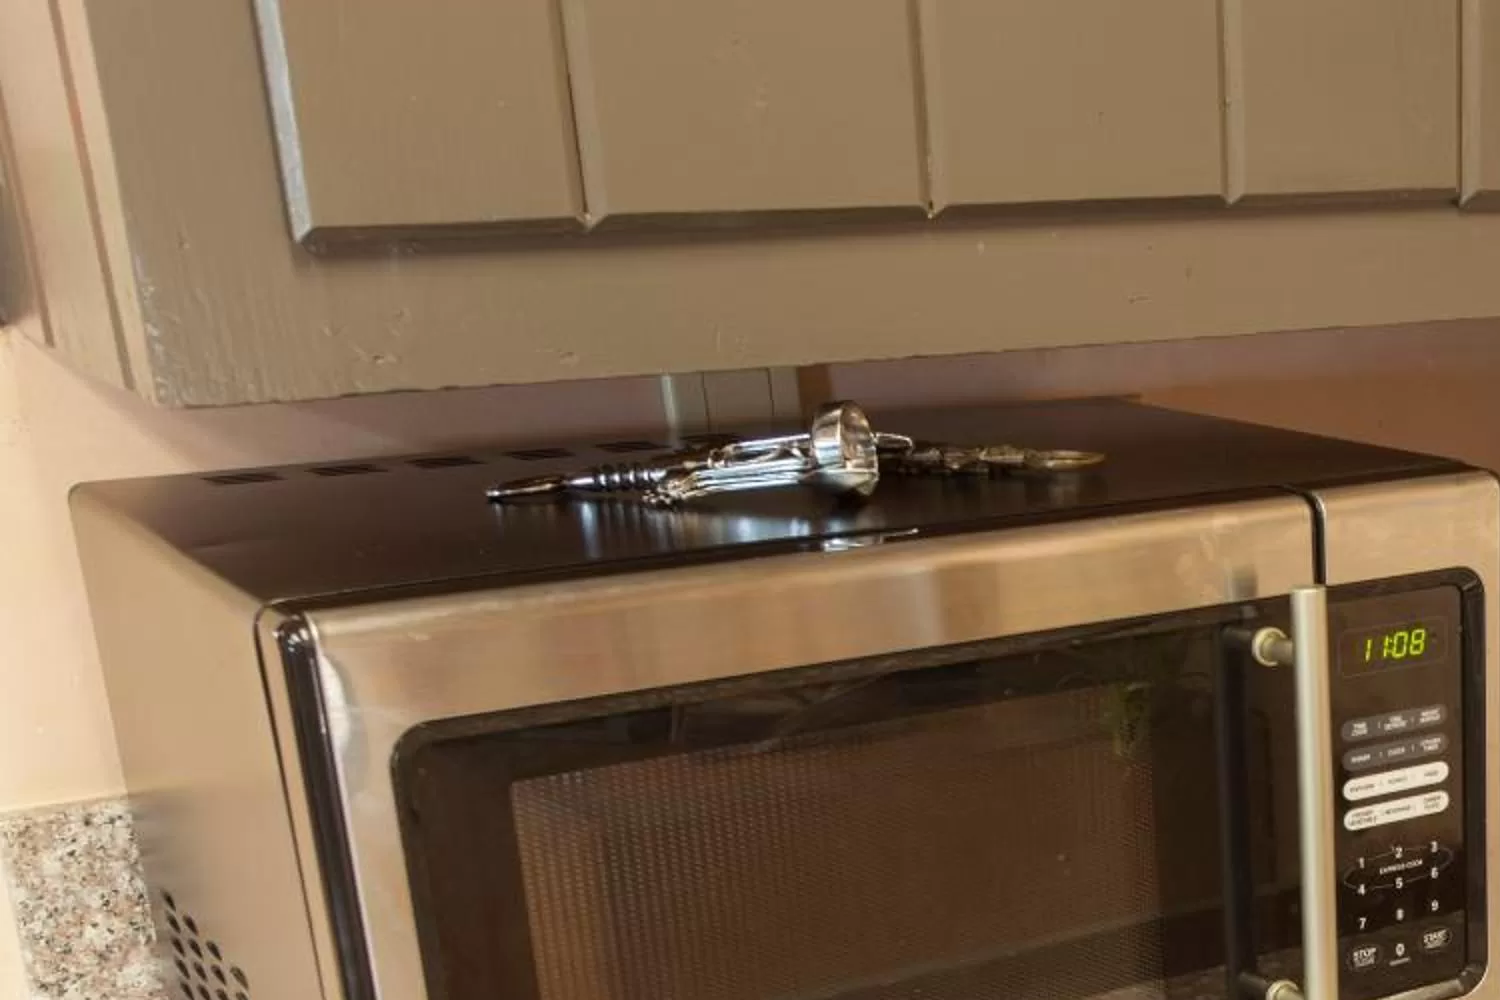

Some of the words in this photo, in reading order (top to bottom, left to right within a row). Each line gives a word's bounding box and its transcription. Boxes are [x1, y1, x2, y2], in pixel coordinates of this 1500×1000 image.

[1364, 627, 1427, 662] 11:08
[1431, 867, 1439, 879] 6
[1357, 883, 1366, 895] 4
[1395, 877, 1404, 889] 5
[1431, 899, 1439, 911] 9
[1359, 917, 1367, 930] 7
[1395, 942, 1405, 957] 0
